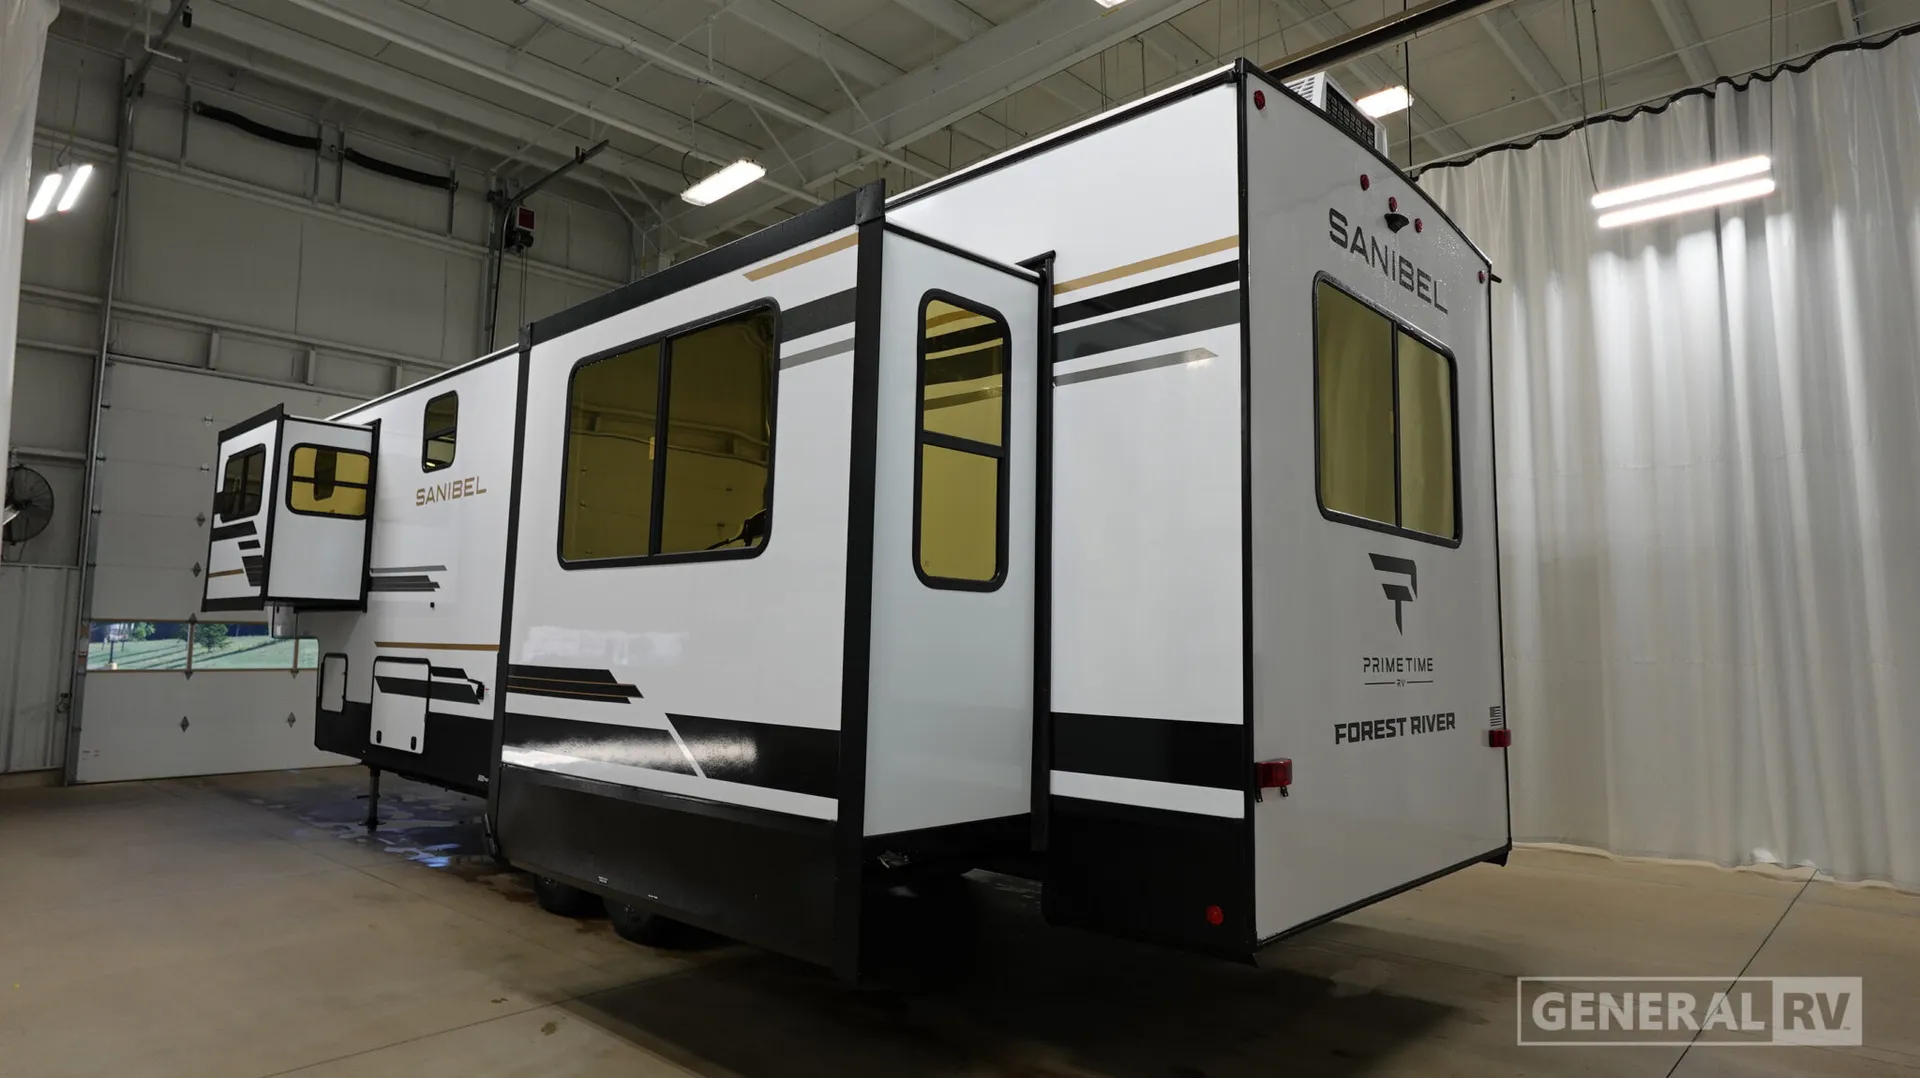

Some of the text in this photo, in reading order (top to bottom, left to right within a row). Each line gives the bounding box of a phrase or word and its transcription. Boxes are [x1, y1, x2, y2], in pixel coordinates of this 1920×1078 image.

[1328, 207, 1448, 314] SANIBEL
[415, 476, 487, 506] SANIBEL
[1396, 679, 1406, 688] RV
[1334, 712, 1456, 745] FOREST RIVER
